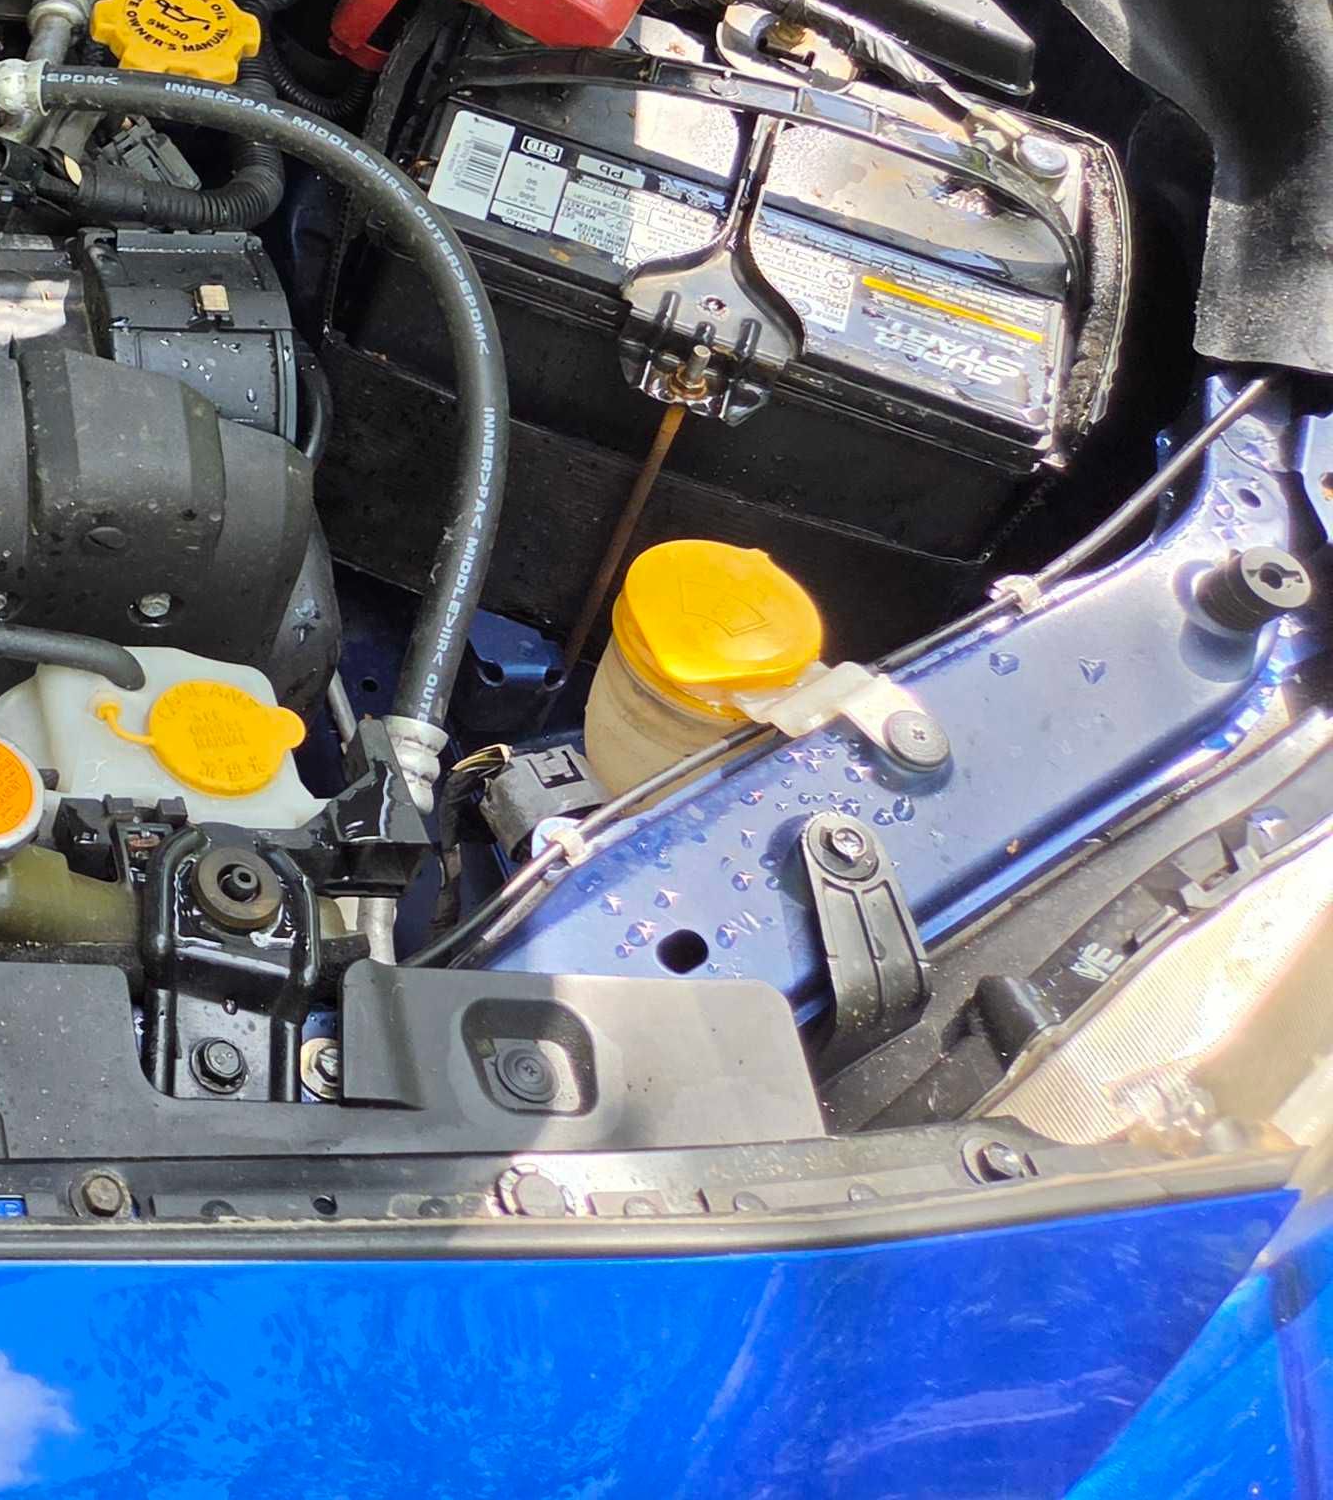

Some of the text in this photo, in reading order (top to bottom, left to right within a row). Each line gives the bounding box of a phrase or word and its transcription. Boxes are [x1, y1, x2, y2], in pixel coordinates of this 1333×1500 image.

[210, 3, 228, 21] OIL
[146, 18, 189, 41] 5W-30
[182, 27, 230, 53] MANUAL
[599, 164, 624, 179] Pb
